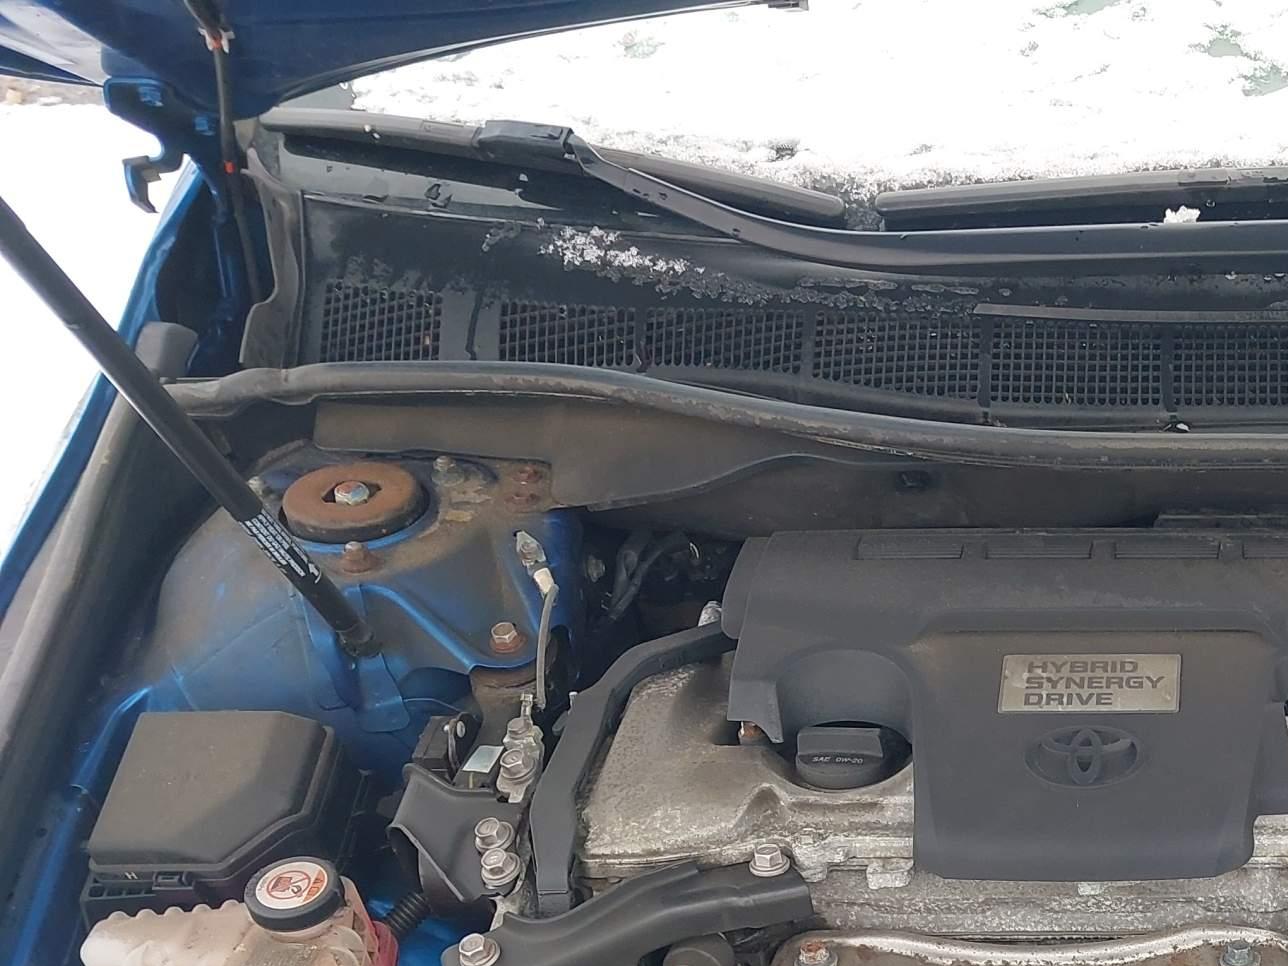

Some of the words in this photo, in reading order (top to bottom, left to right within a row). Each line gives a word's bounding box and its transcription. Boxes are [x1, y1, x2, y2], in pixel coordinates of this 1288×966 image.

[1027, 660, 1138, 674] HYBRID
[1025, 676, 1165, 690] SYNERGY
[1023, 692, 1114, 706] DRIVE
